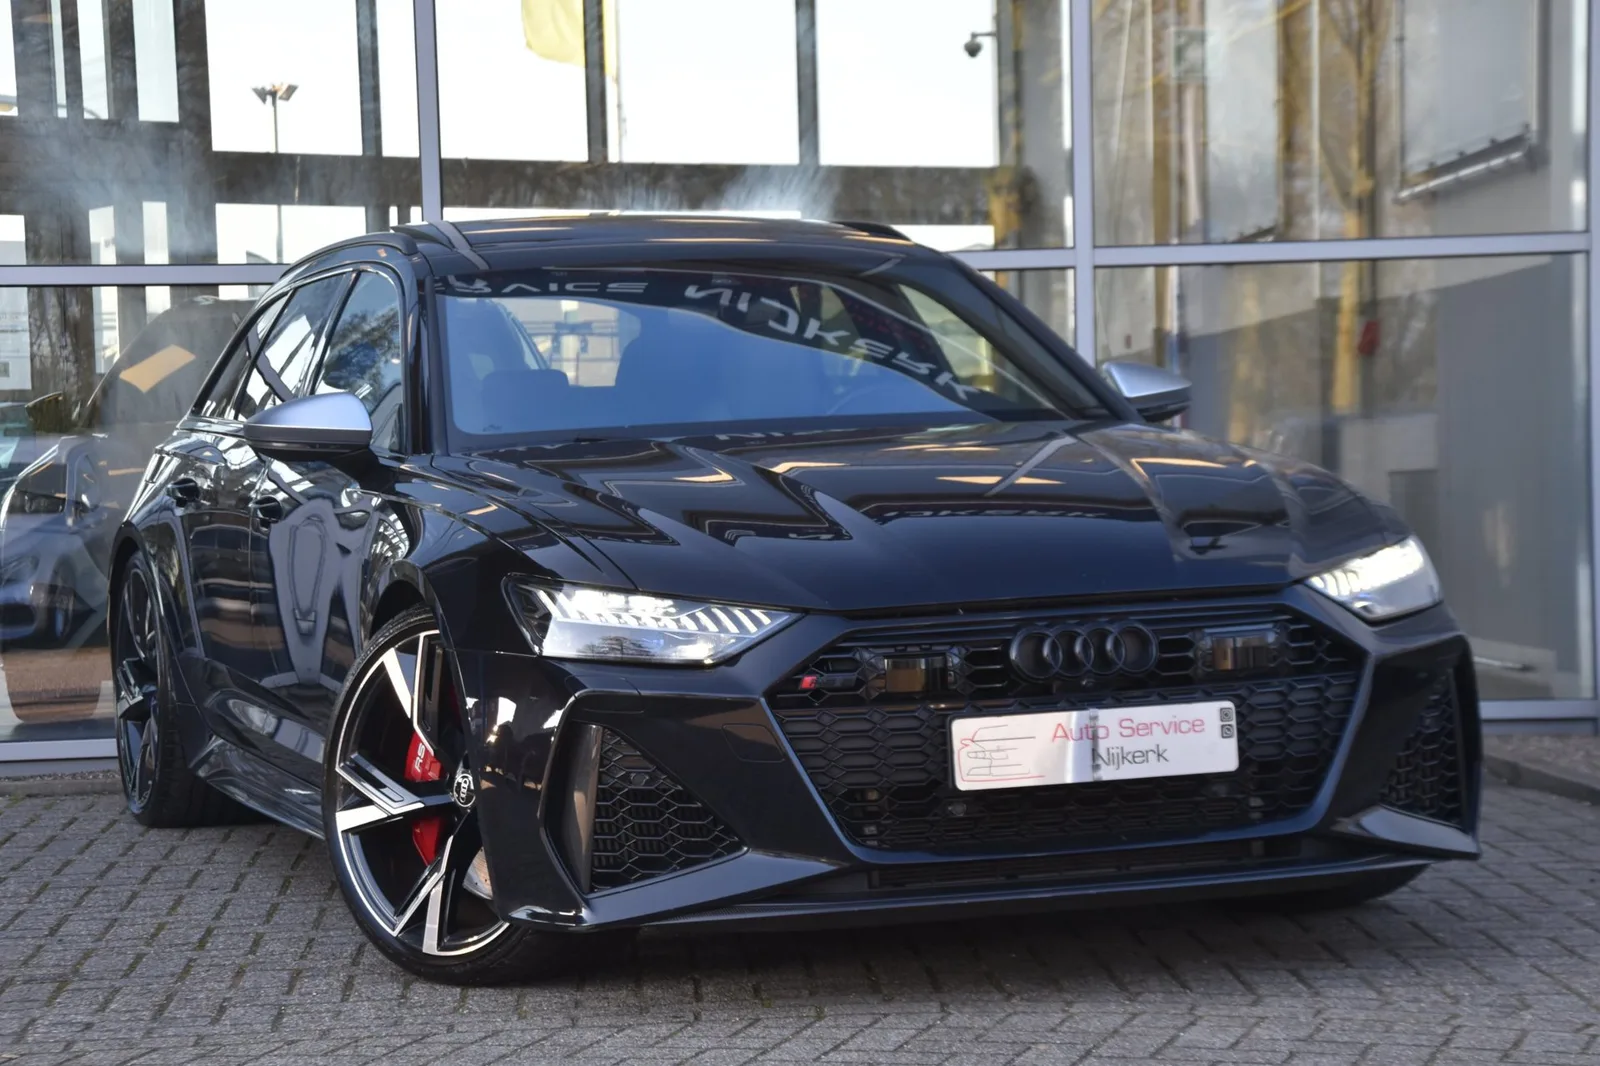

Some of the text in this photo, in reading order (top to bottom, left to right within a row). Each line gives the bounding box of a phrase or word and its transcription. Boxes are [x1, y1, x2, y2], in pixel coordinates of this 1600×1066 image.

[1051, 714, 1206, 743] Auto Service
[414, 743, 426, 772] RS
[1092, 743, 1170, 771] Nijkerk
